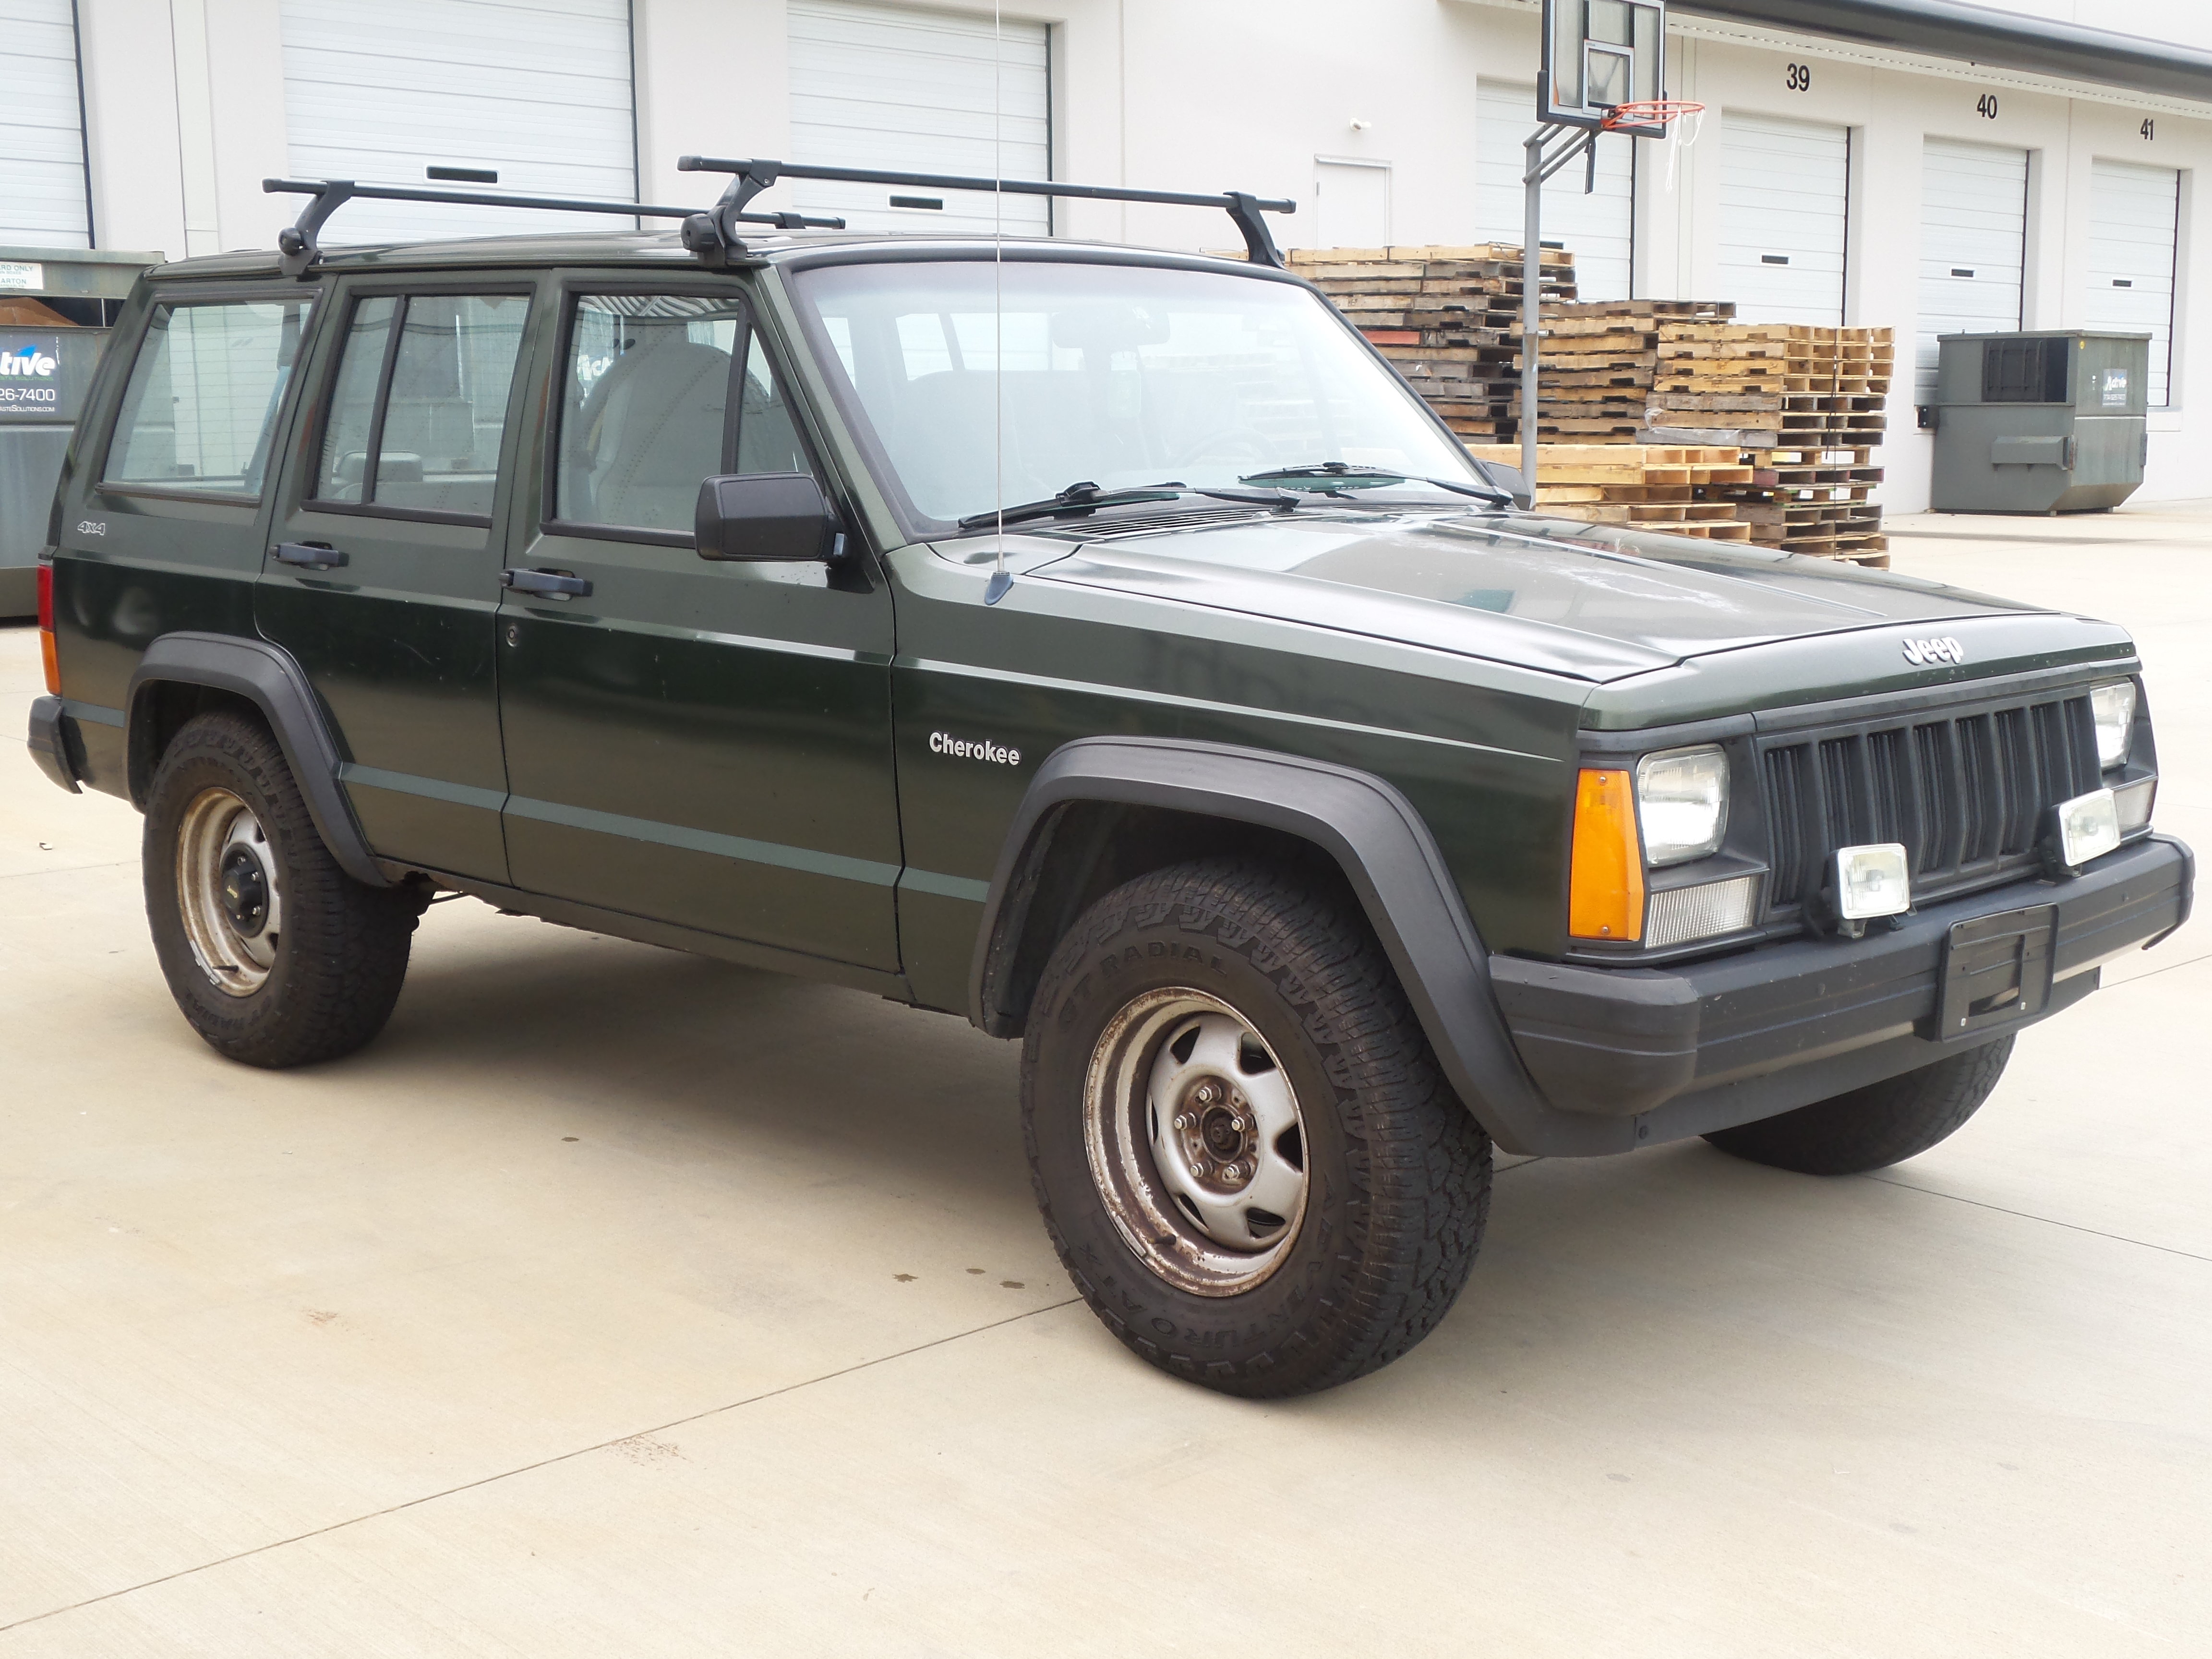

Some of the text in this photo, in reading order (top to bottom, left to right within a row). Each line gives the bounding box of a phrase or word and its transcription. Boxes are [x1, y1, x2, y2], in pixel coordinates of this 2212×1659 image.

[1786, 63, 1811, 92] 39
[1976, 93, 1998, 120] 40
[2140, 118, 2154, 141] 41
[1902, 637, 1964, 665] Jeep
[929, 731, 1020, 766] Cherokee
[1100, 940, 1228, 978] RADIAL
